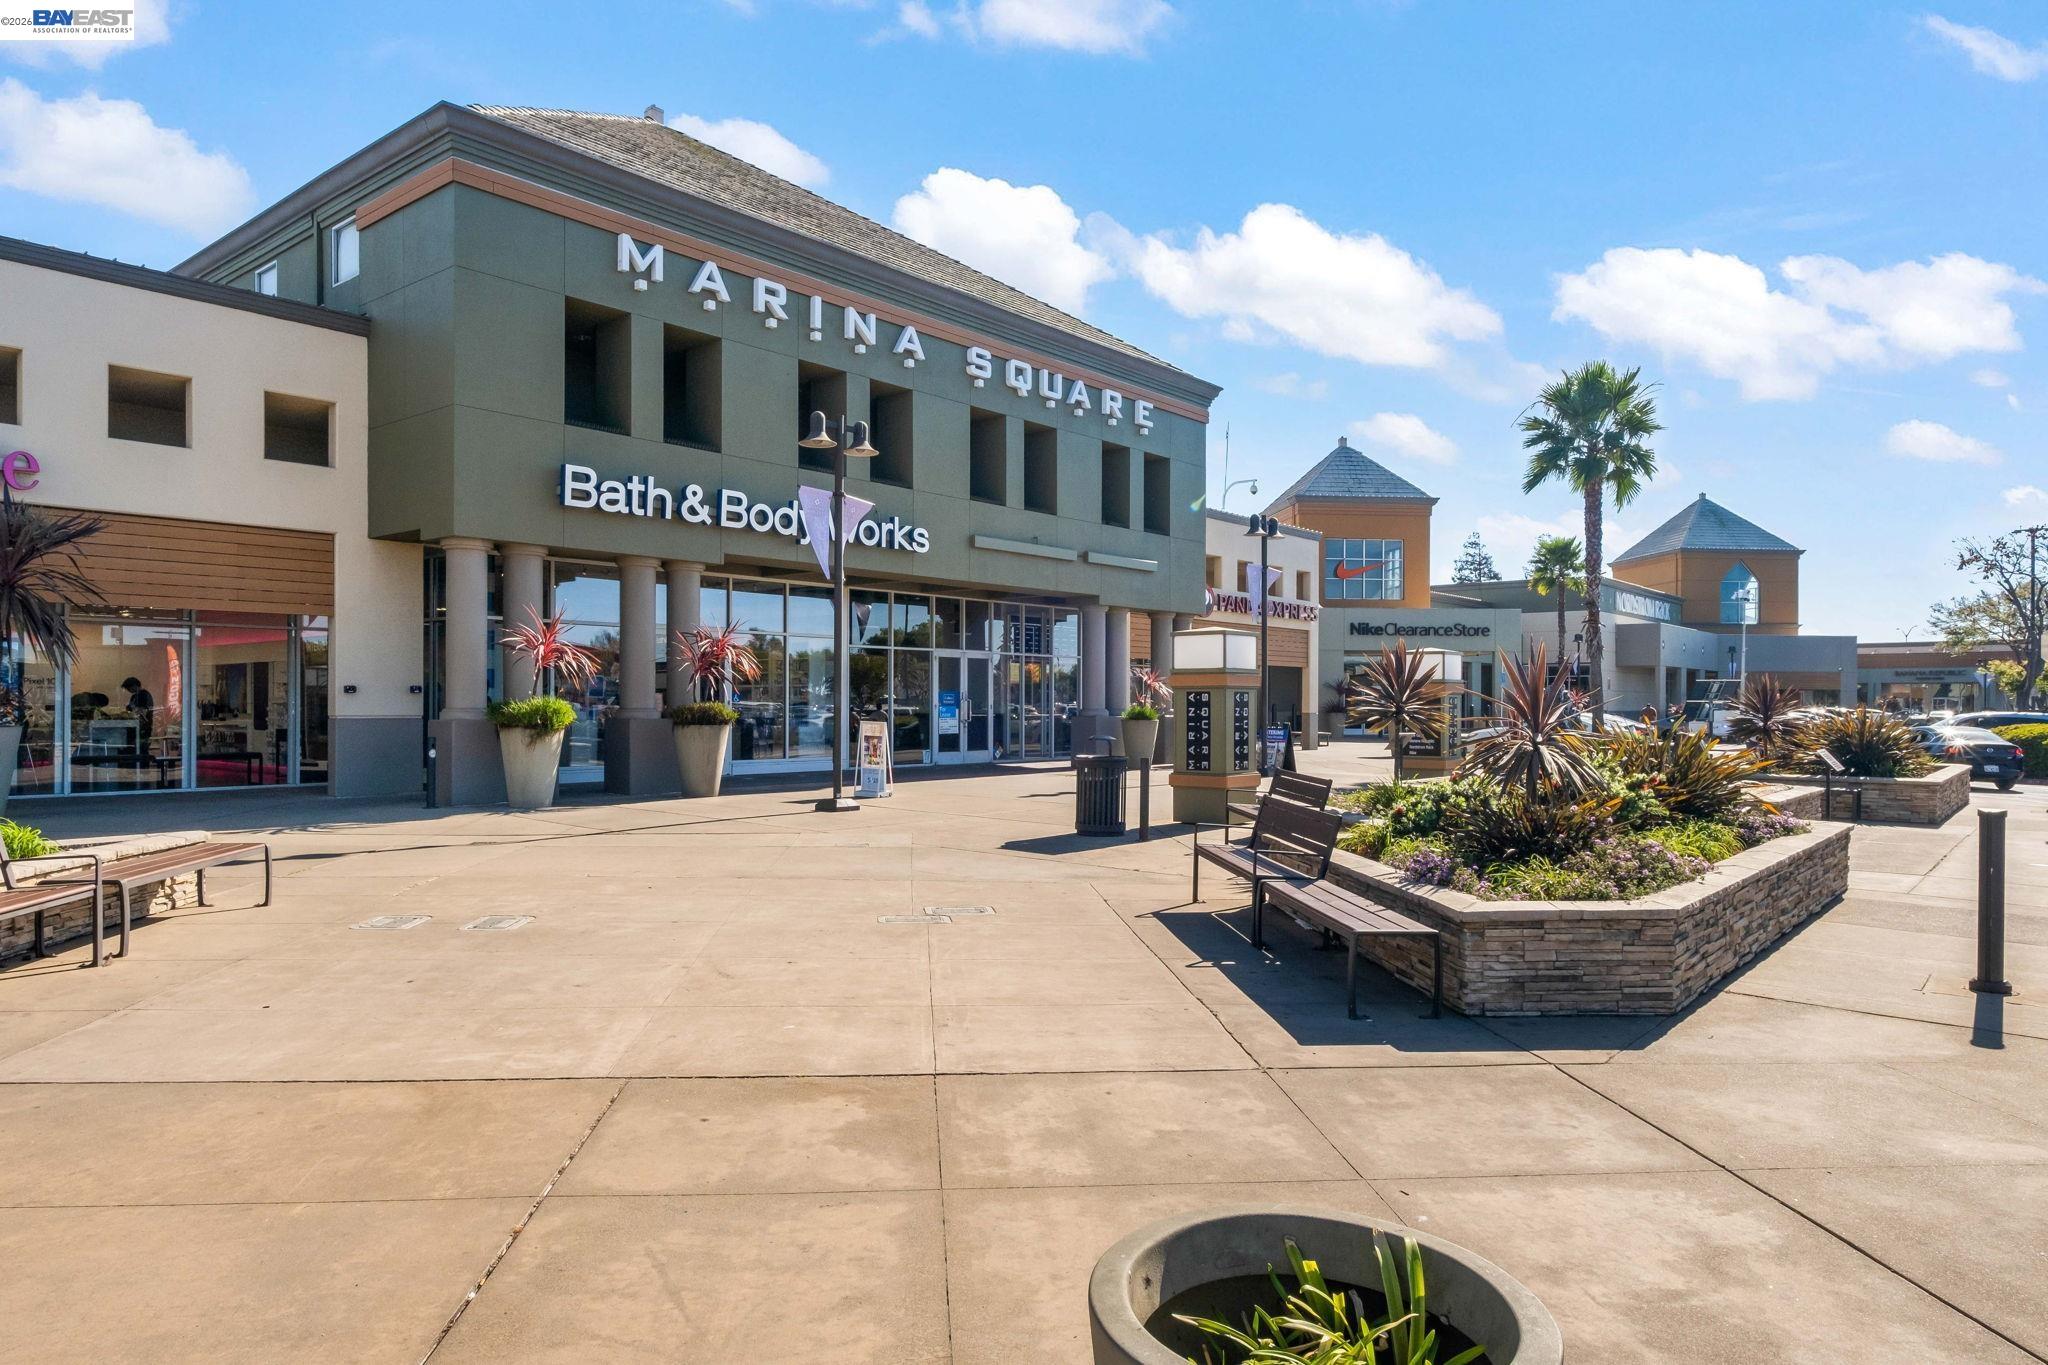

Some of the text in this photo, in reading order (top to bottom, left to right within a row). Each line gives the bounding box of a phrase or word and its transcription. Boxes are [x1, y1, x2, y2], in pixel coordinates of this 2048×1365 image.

[617, 233, 1155, 436] MARINA SQUARE
[560, 463, 673, 520] Bath
[677, 483, 713, 526] &
[1201, 693, 1209, 769] SQUARE
